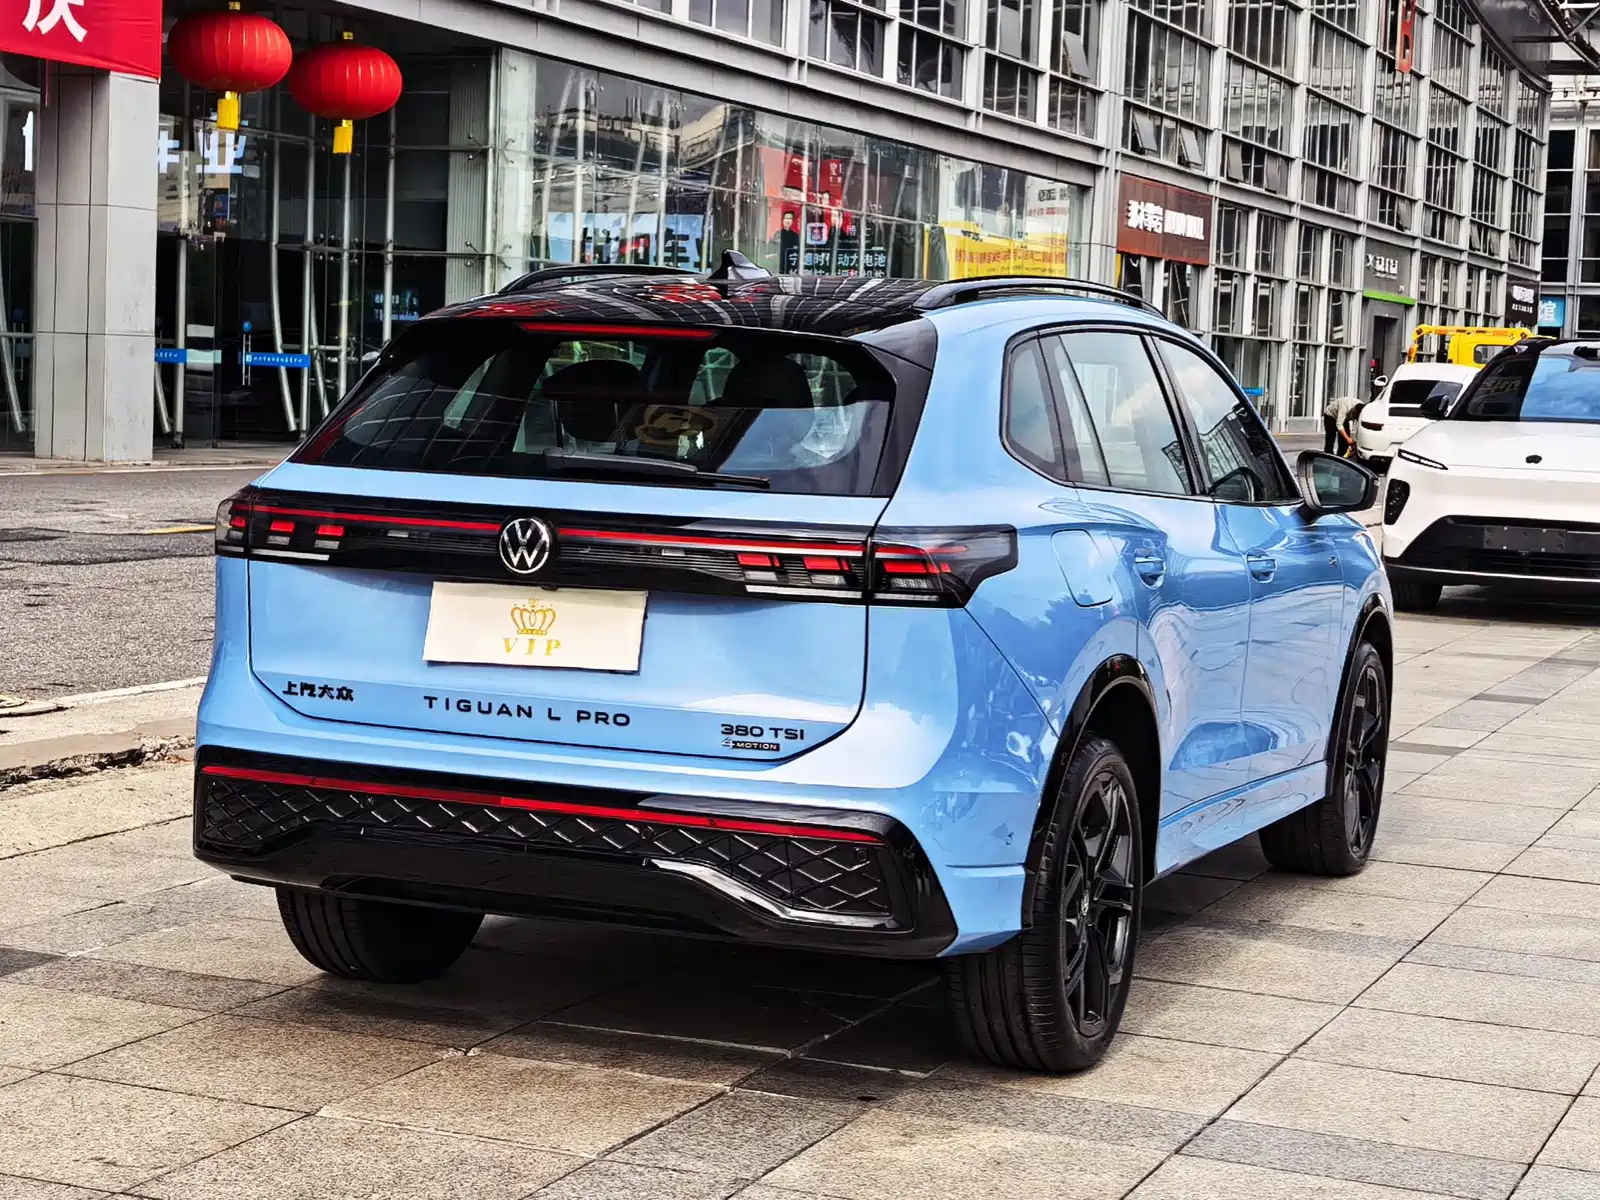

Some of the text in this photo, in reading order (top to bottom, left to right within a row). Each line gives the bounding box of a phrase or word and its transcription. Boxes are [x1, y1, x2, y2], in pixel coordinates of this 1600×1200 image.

[502, 637, 562, 657] VIP
[282, 680, 355, 702] 上汽大众
[422, 695, 632, 727] TIGUAN L PRO
[720, 723, 805, 741] 380 TSI
[721, 736, 780, 752] 4MOTION
